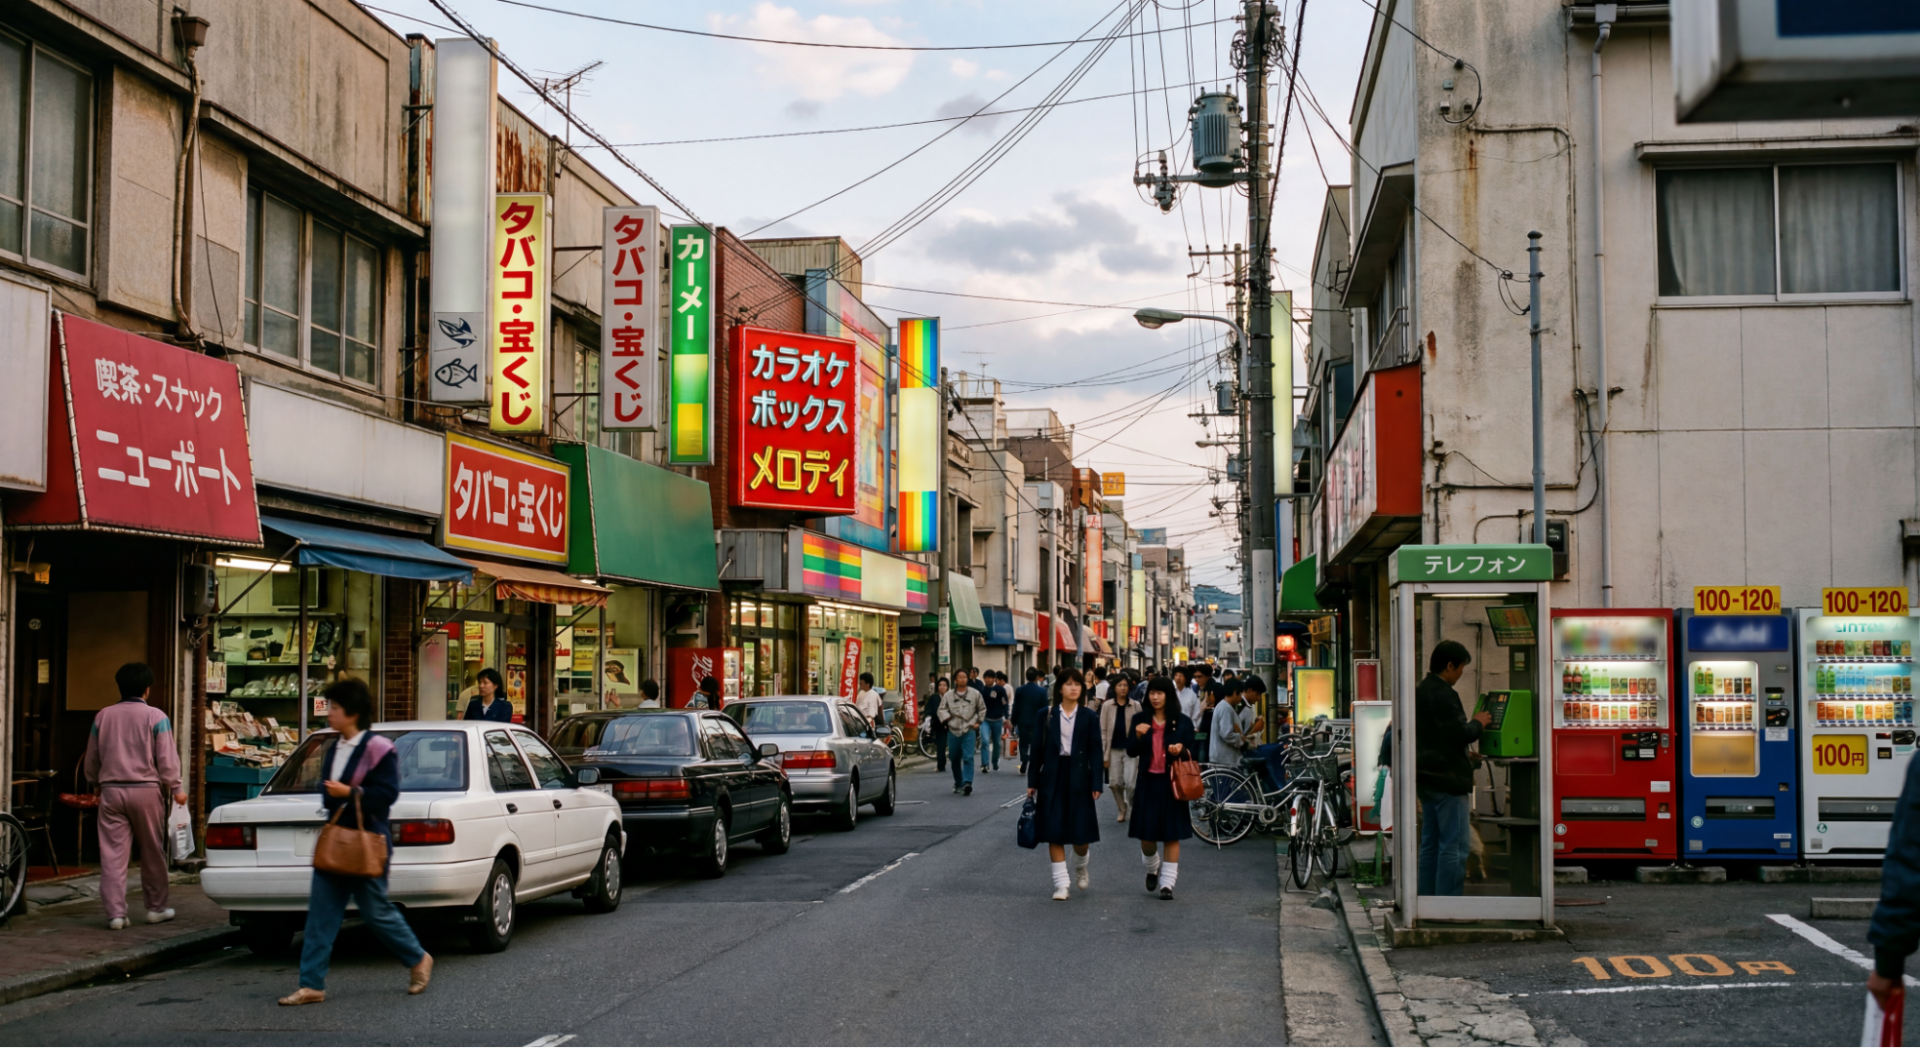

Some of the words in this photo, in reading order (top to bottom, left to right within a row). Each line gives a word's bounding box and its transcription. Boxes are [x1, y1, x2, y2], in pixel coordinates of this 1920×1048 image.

[499, 201, 535, 426] タバコ・宝くじ
[612, 214, 645, 422] タバコ・宝くじ
[95, 357, 222, 422] 喫茶・スナック
[752, 343, 849, 387] カラオケ
[751, 389, 848, 434] ボックス
[96, 429, 241, 505] ニューポート
[750, 445, 849, 497] メロディ
[453, 460, 563, 538] タバコ・宝くじ
[1424, 555, 1526, 575] テレフォン
[1815, 743, 1865, 767] 100円
[1571, 953, 1797, 980] 100円
